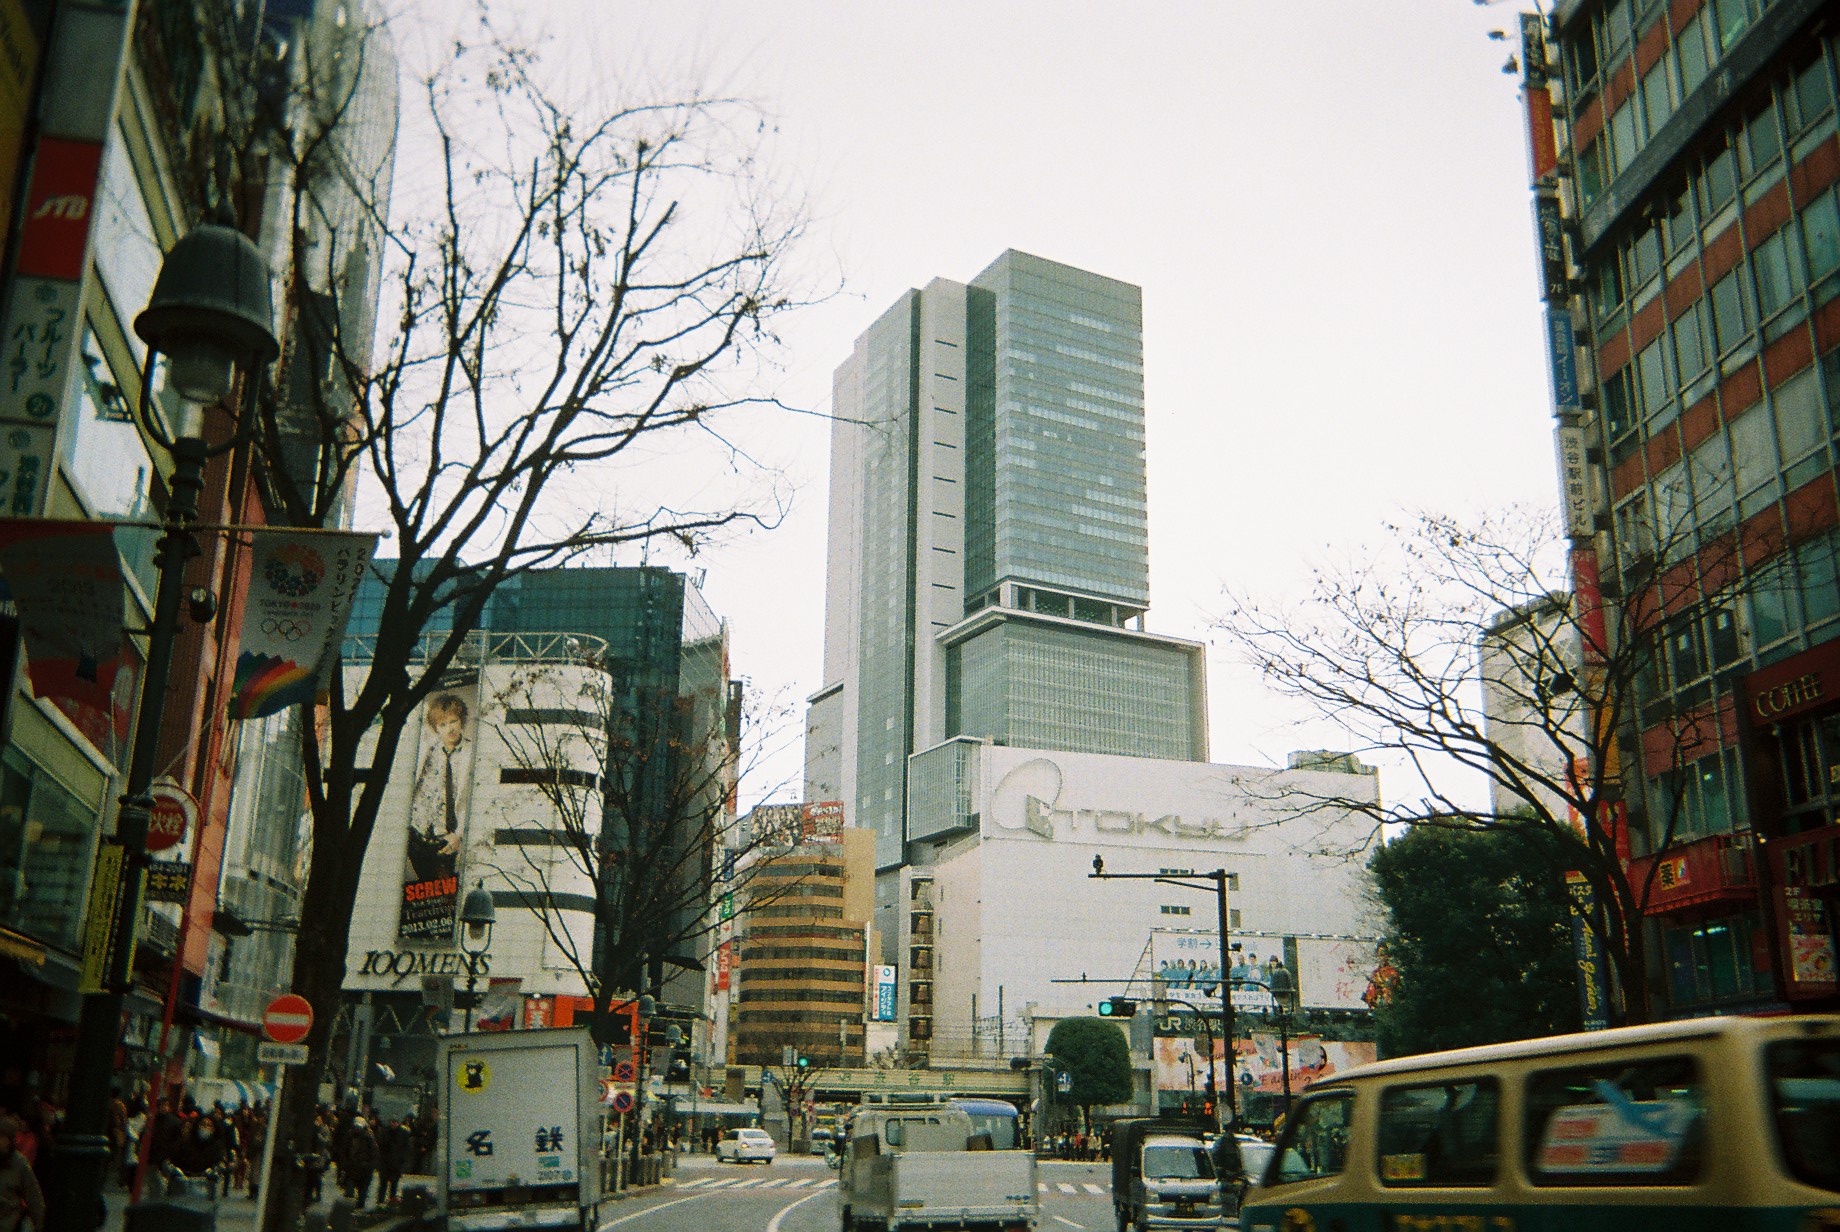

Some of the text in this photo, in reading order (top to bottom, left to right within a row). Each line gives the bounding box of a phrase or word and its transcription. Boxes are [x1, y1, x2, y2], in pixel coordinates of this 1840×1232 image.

[32, 194, 89, 222] JTB
[405, 876, 458, 902] SCREW
[1159, 1016, 1182, 1031] JR
